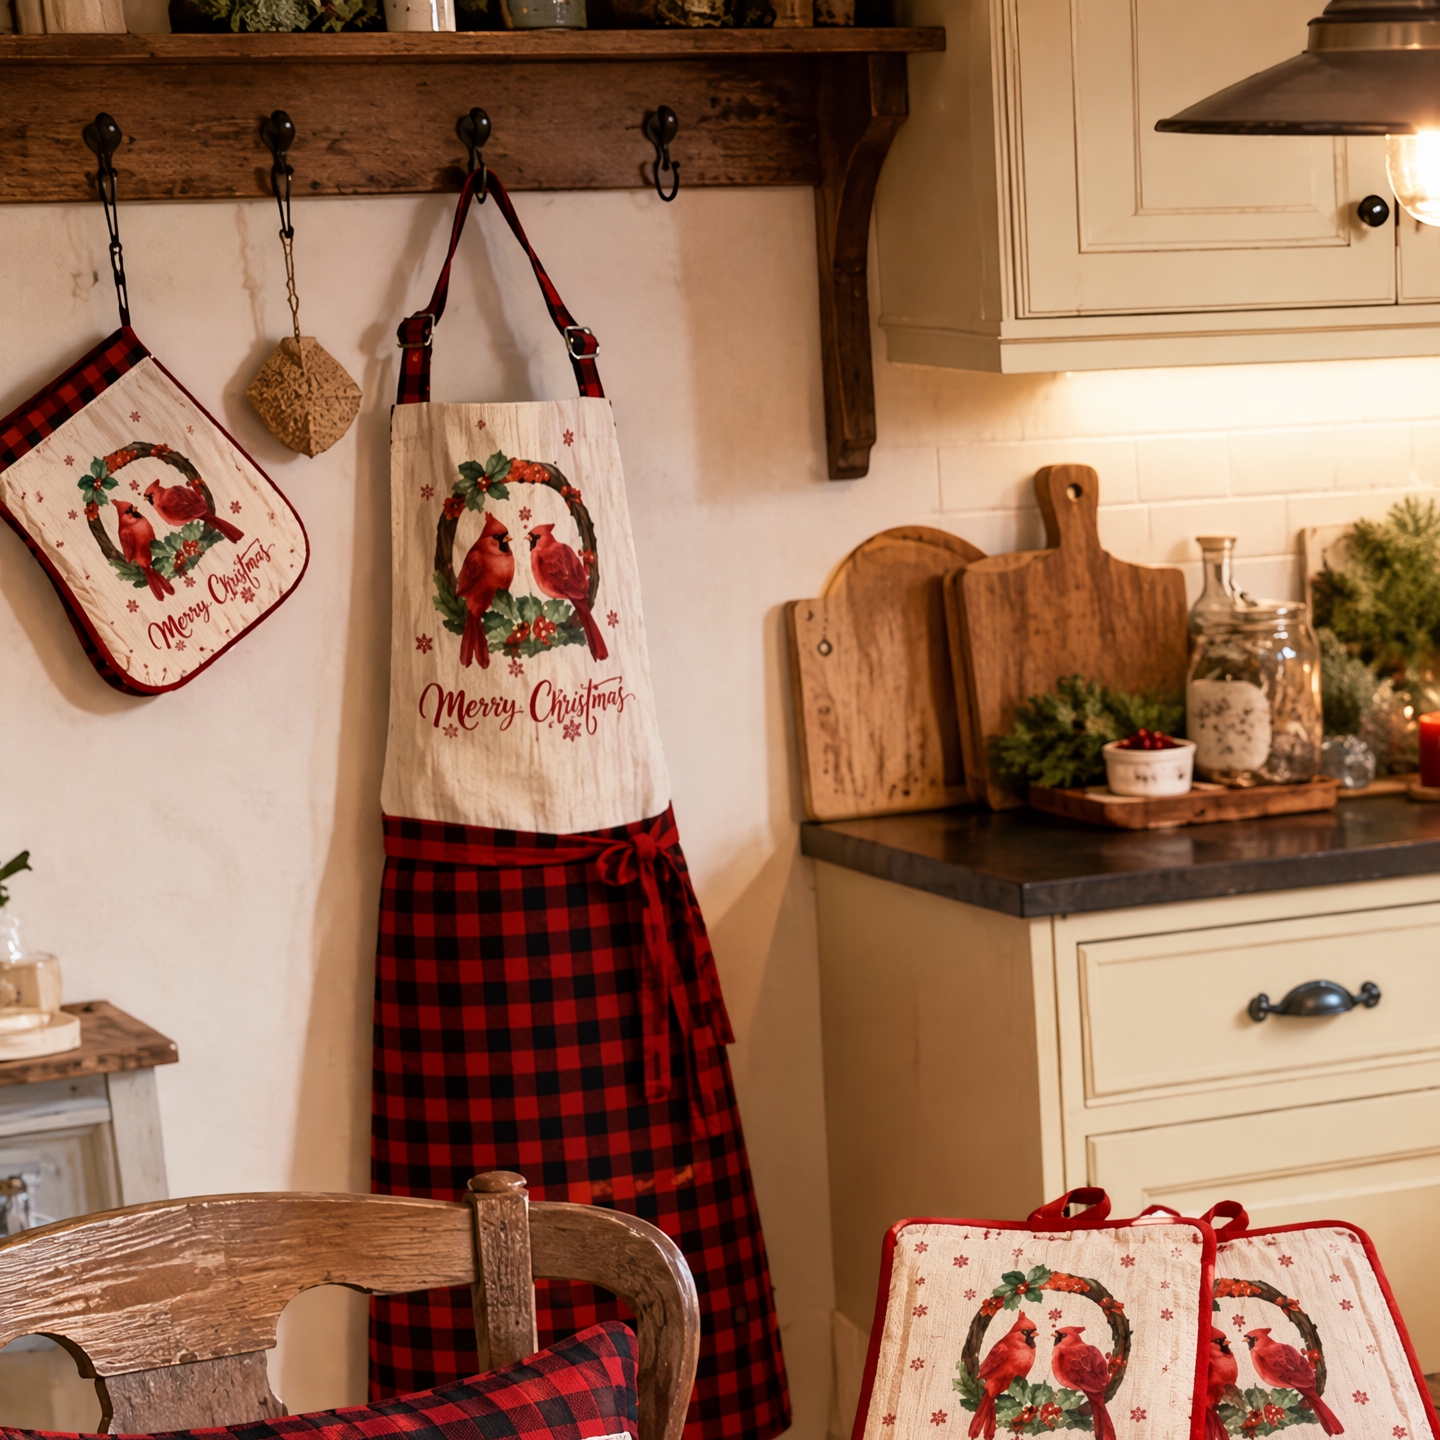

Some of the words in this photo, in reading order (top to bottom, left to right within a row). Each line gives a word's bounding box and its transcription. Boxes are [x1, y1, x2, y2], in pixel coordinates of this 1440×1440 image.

[148, 599, 213, 650] Merry
[207, 537, 276, 605] Christmas
[419, 682, 525, 731] Merry
[529, 676, 636, 735] Christmas
